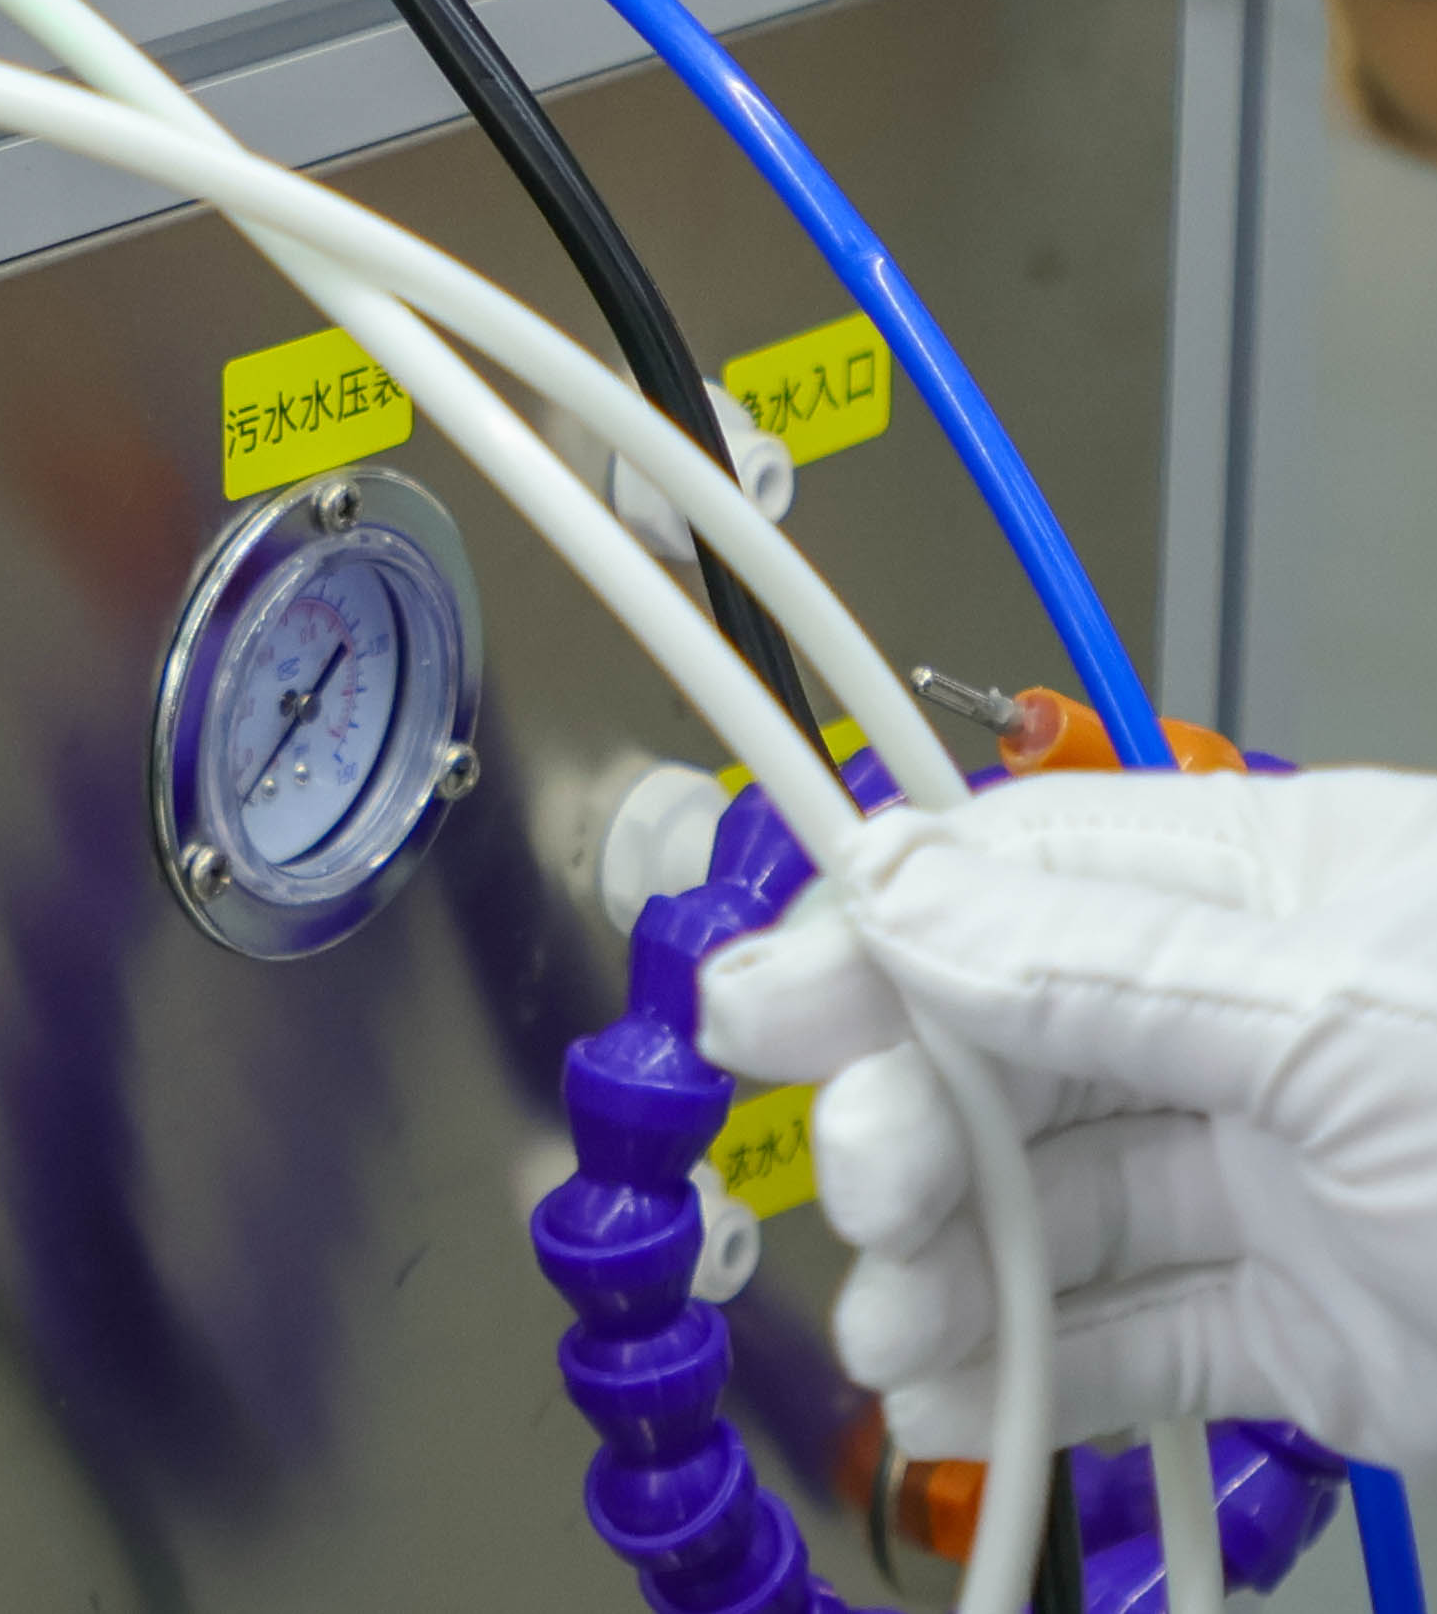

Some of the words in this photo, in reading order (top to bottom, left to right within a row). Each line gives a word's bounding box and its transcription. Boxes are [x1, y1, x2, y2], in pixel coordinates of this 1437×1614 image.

[225, 364, 404, 459] 污水水压表
